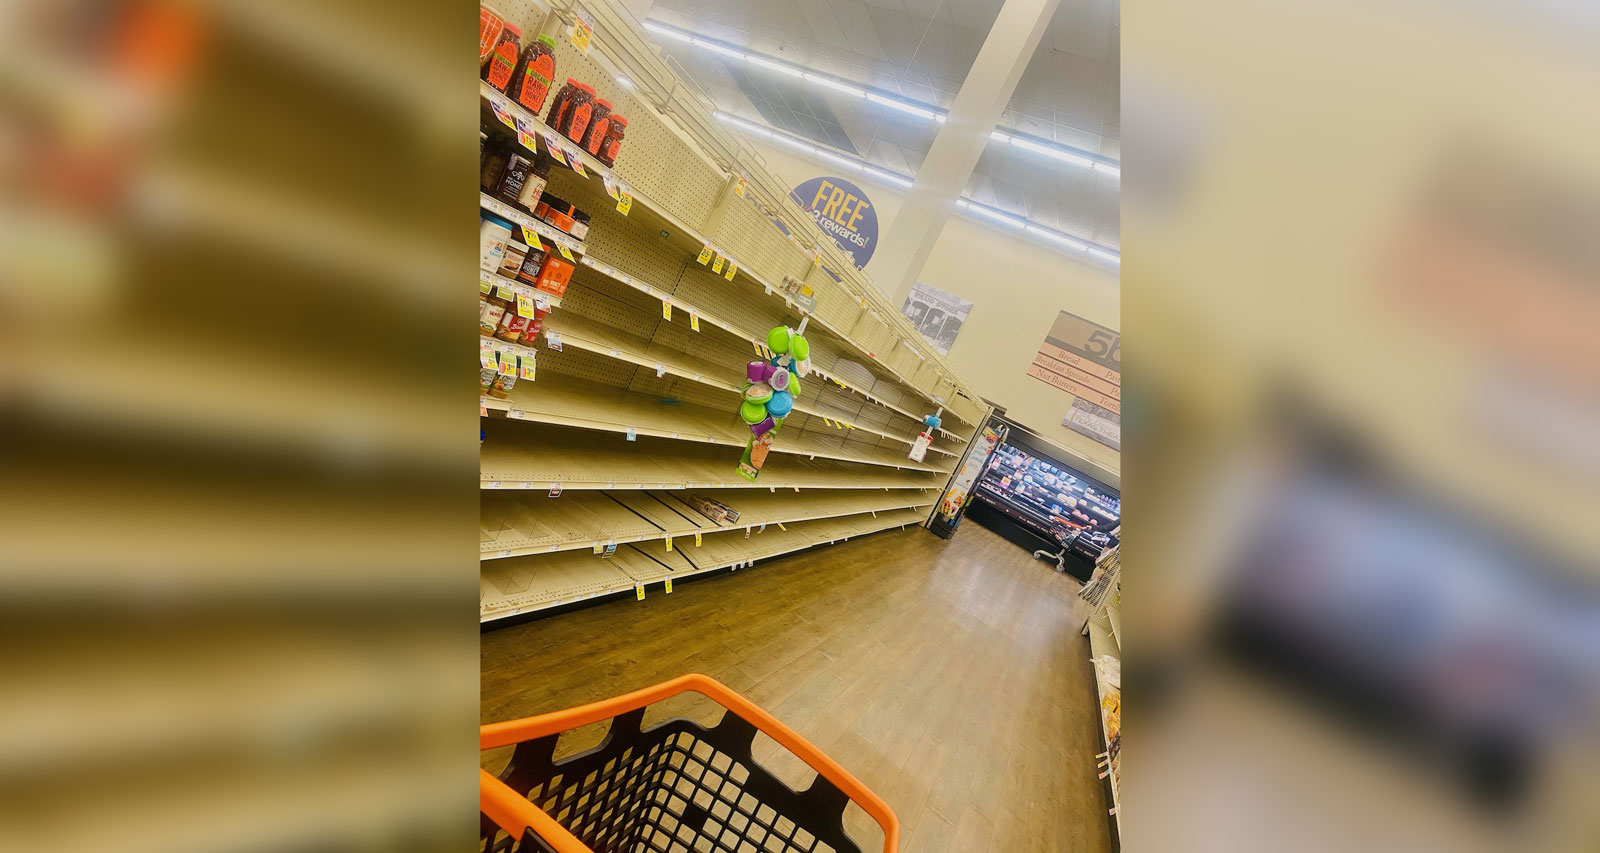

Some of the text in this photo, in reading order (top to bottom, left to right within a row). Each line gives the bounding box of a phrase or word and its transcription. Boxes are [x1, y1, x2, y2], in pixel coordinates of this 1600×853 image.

[528, 76, 542, 91] RAW
[811, 180, 870, 232] FREE
[820, 216, 870, 249] rewards!
[914, 292, 935, 304] DRUG
[1058, 351, 1080, 365] Bread
[1035, 355, 1090, 384] Breakfast Spreads
[1036, 369, 1077, 392] Nut Butters
[1110, 387, 1120, 397] Pa
